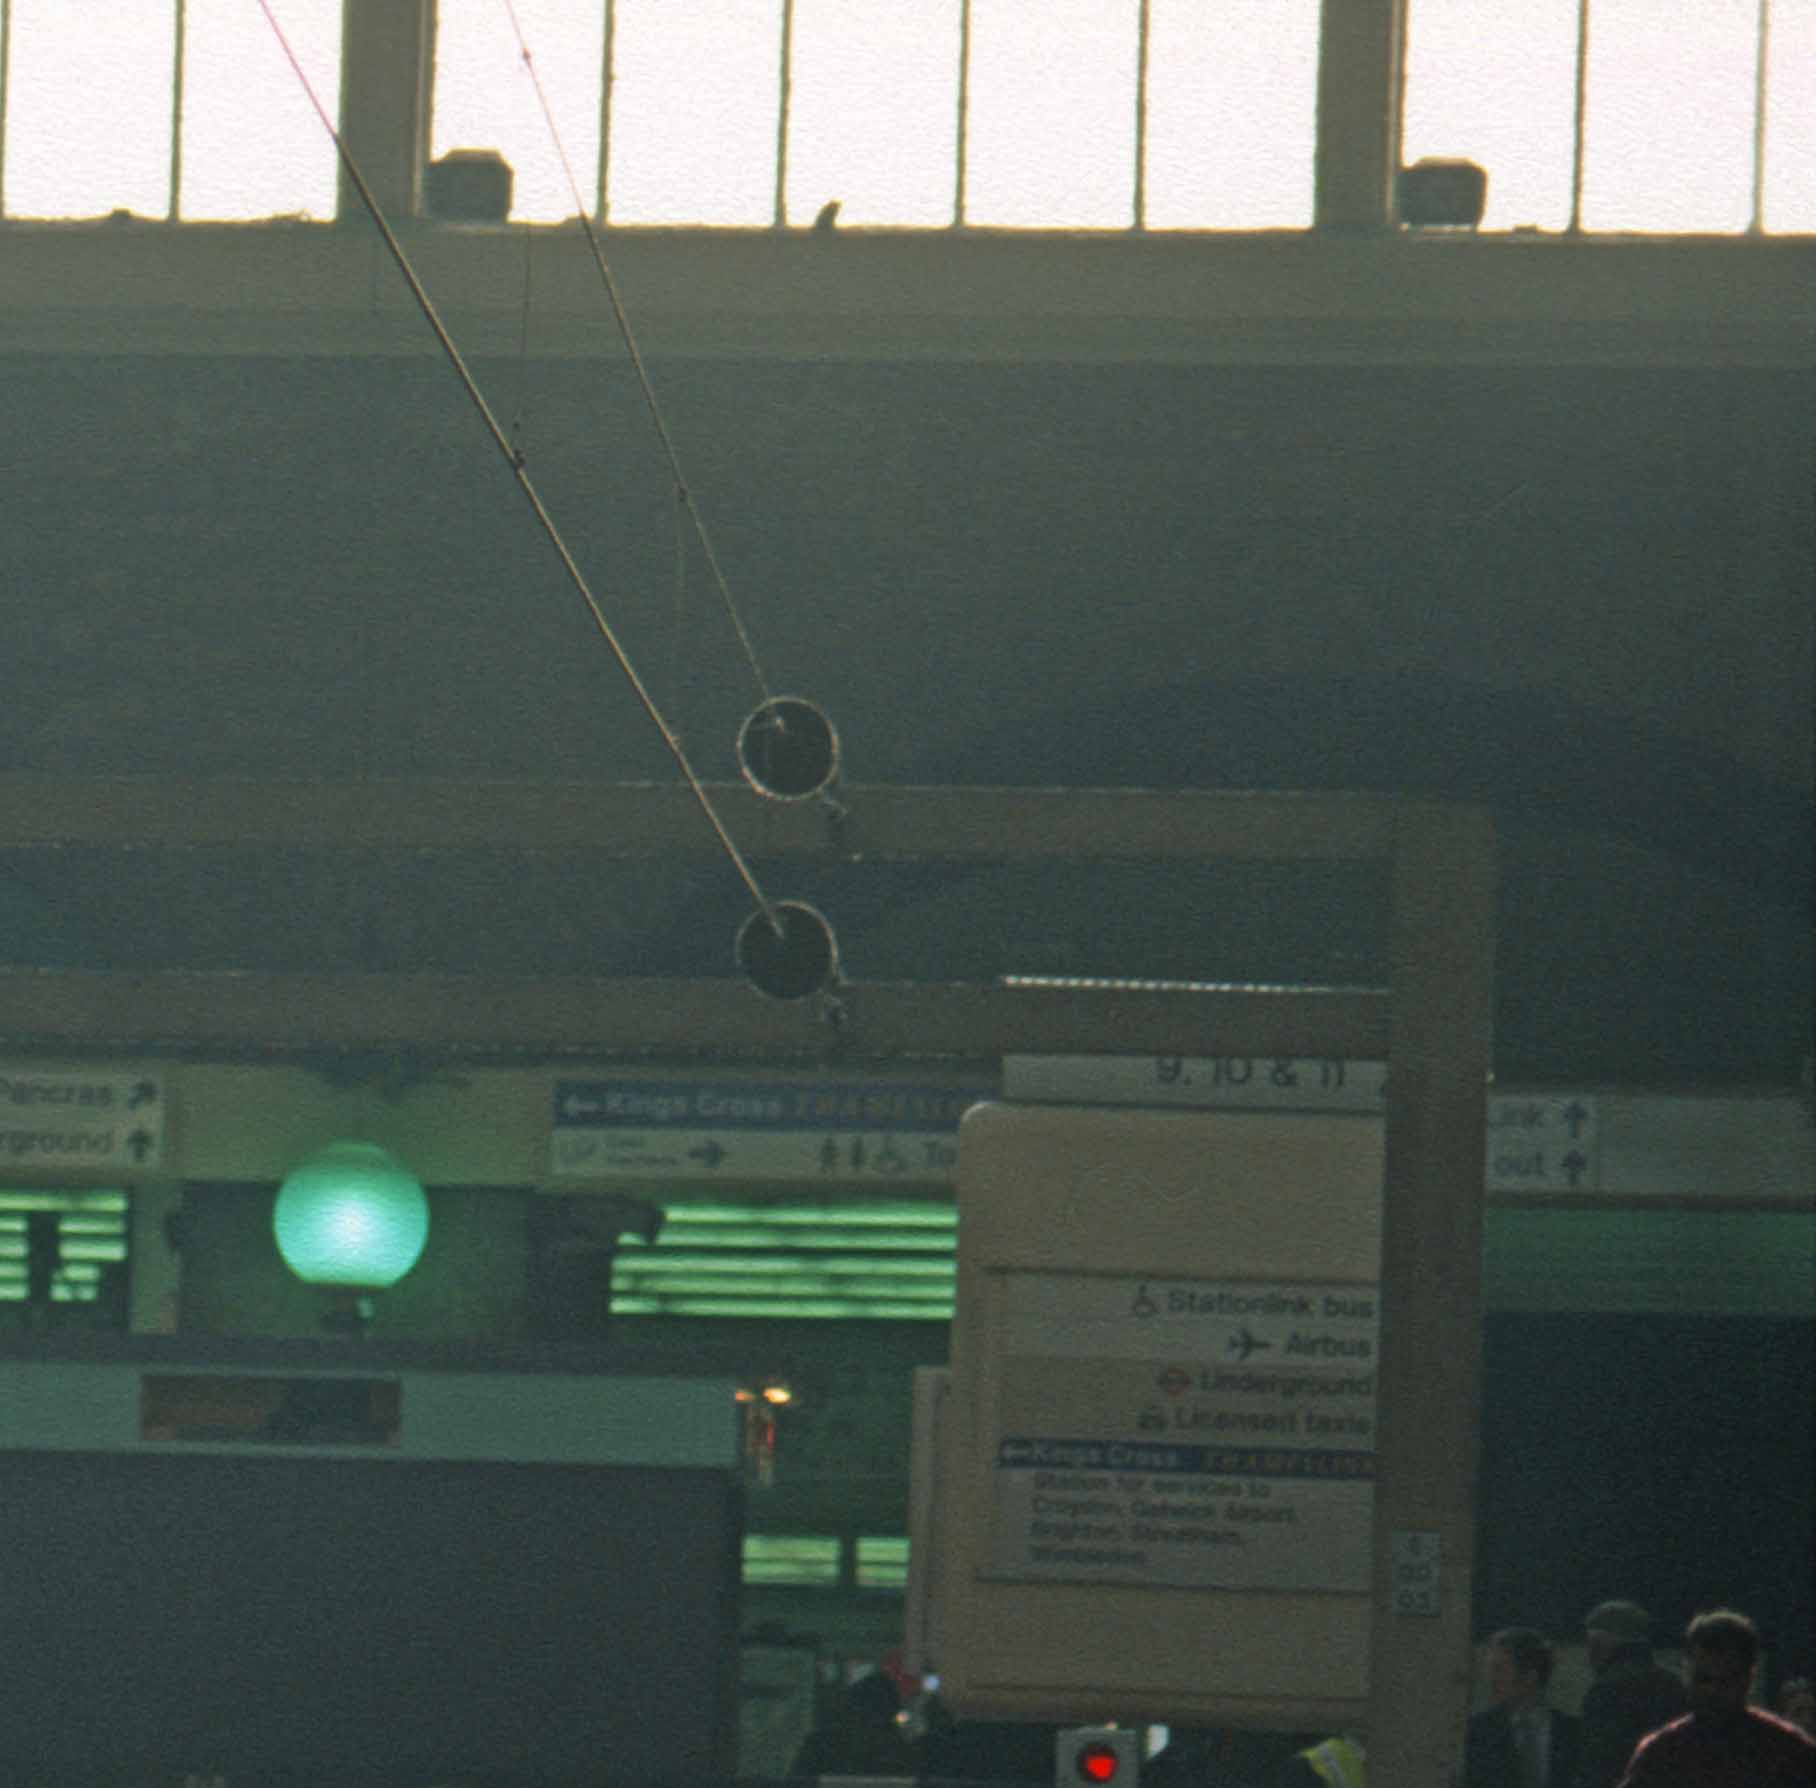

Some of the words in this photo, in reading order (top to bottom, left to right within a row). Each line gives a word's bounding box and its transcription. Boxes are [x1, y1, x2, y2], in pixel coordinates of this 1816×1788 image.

[1212, 1057, 1254, 1087] 10
[606, 1091, 688, 1121] Kings
[696, 1091, 781, 1119] Cross
[1495, 1151, 1545, 1177] out
[1167, 1289, 1315, 1318] Stationlink
[1323, 1296, 1374, 1319] bus
[1285, 1331, 1372, 1358] Airbus
[1200, 1373, 1373, 1399] Underground
[1174, 1408, 1296, 1434] Licensed
[1304, 1411, 1371, 1435] taxis
[1032, 1443, 1101, 1467] Kings
[1106, 1445, 1179, 1467] Cross
